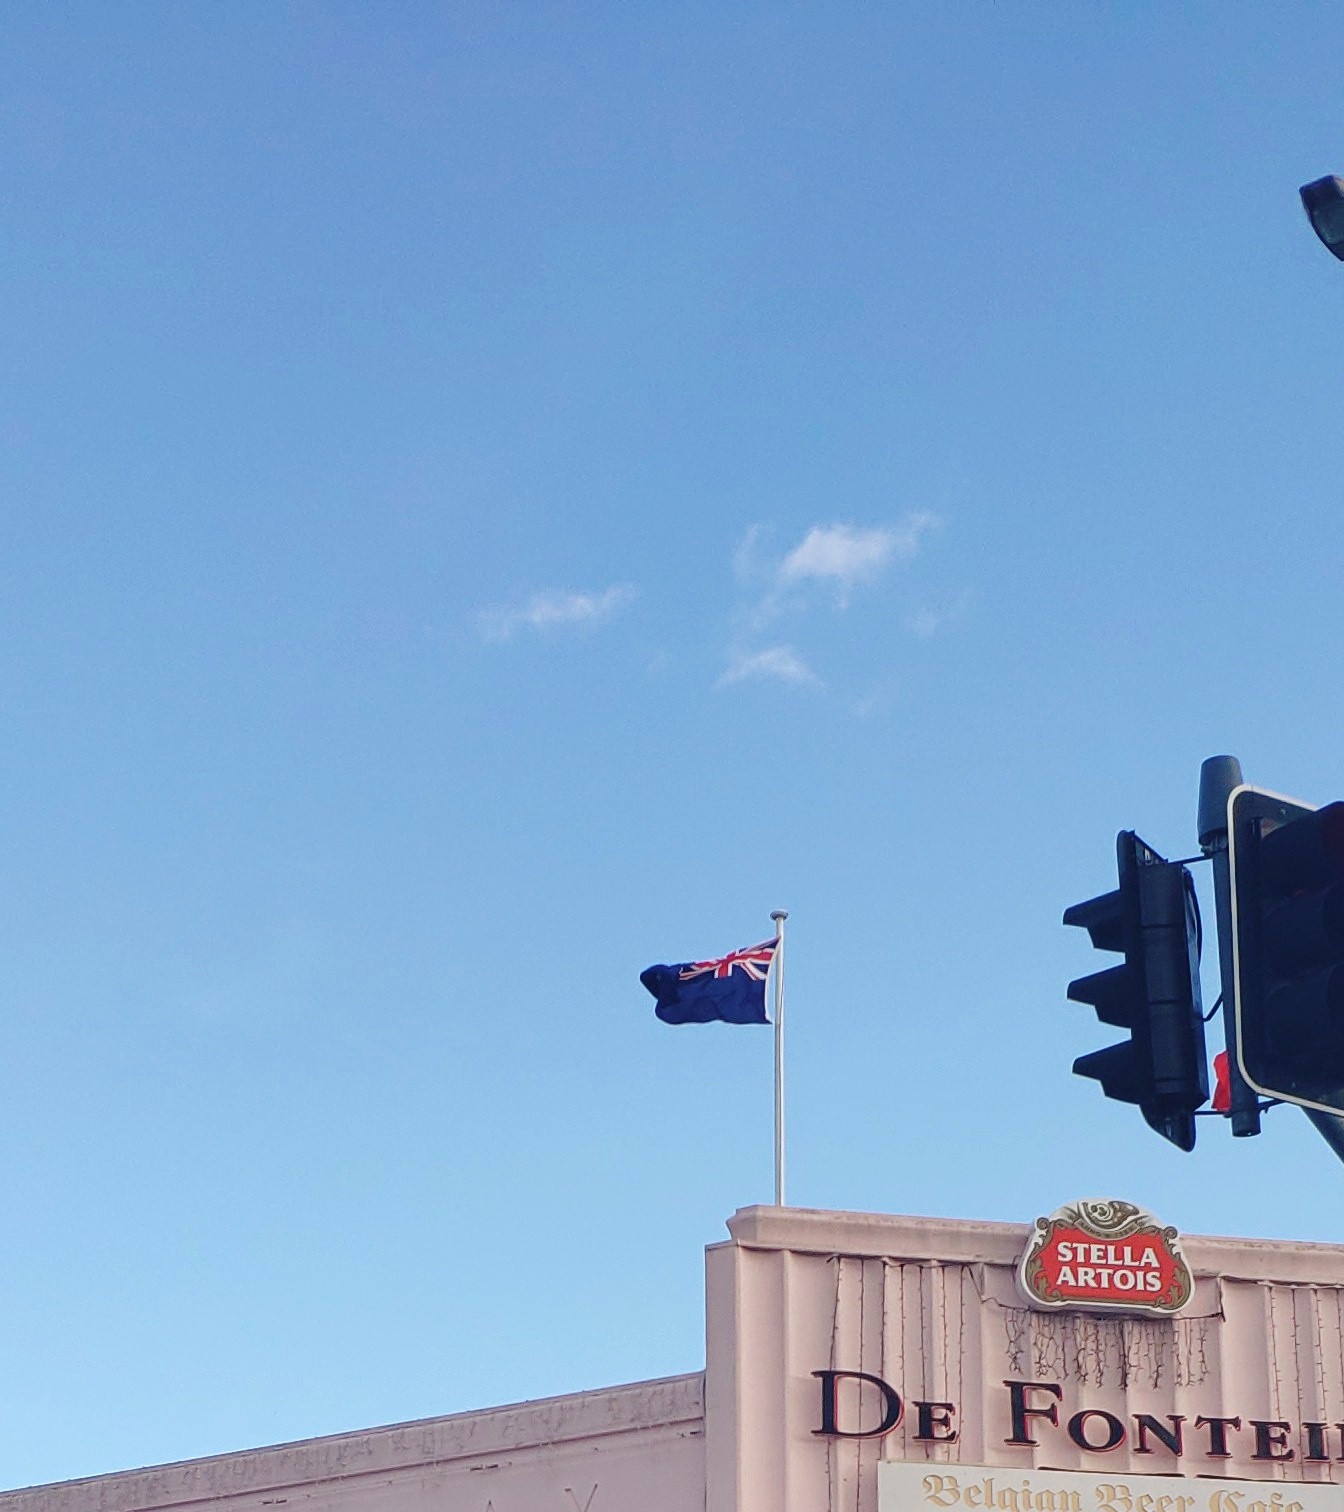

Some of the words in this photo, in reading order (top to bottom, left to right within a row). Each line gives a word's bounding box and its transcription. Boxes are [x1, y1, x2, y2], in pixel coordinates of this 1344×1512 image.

[1057, 1241, 1160, 1268] STELLA
[1056, 1265, 1162, 1292] ARTOIS
[811, 1369, 958, 1444] DE
